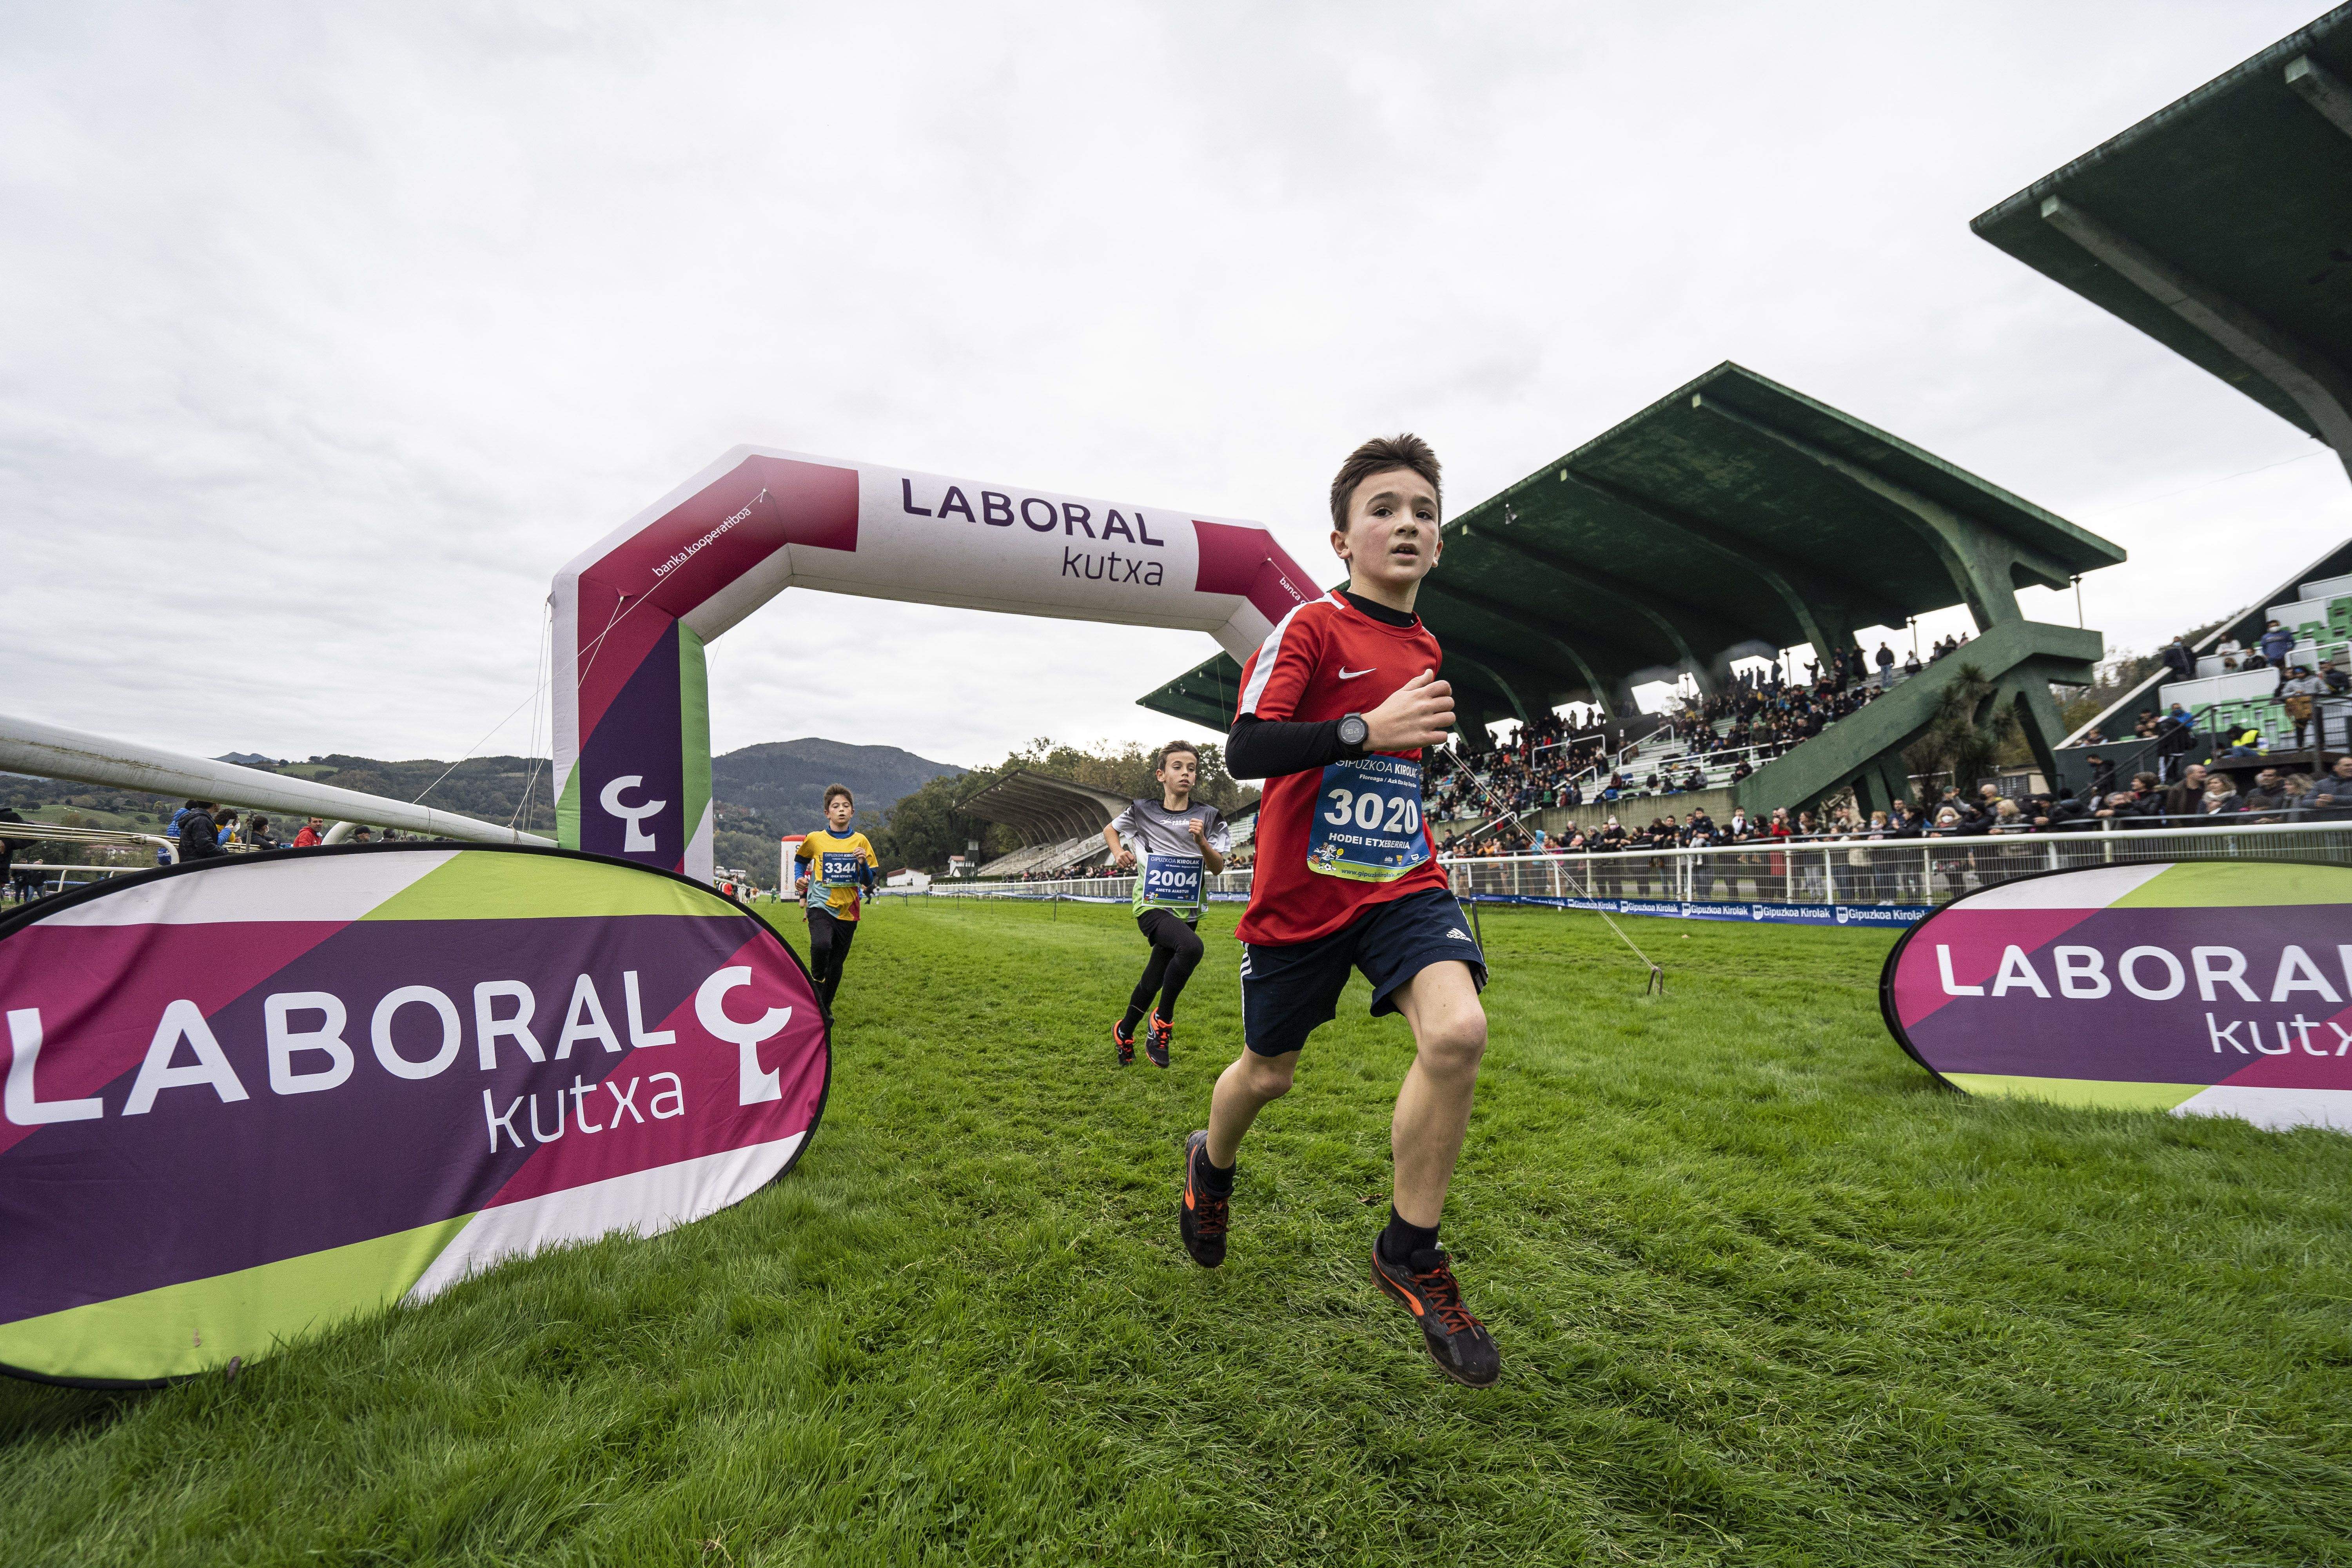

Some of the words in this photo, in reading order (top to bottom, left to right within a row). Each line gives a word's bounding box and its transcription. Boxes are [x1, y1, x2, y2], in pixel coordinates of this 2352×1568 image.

[902, 478, 1164, 547] LABORAL
[652, 552, 688, 577] banka
[684, 508, 751, 556] kooperatiboa
[1062, 546, 1164, 586] kutxa
[1279, 576, 1301, 601] banca
[1359, 774, 1383, 782] Floreaga
[1324, 788, 1419, 835] 3020
[1328, 833, 1362, 844] HODEI
[1365, 837, 1411, 849] ETXEBERRIA
[824, 862, 856, 874] 3344
[1148, 869, 1197, 887] 2004
[1629, 903, 1655, 912] Gipuzkoa
[1656, 904, 1678, 913] Kirolak
[1691, 905, 1722, 915] Gipuzkoa
[1723, 906, 1748, 915] Kirolak
[1764, 907, 1799, 918] Gipuzkoa
[1800, 907, 1831, 918] Kirolak
[1848, 909, 1891, 920] Gipuzkoa
[4, 969, 677, 1126] LABORAL
[482, 1071, 685, 1154] kutxa
